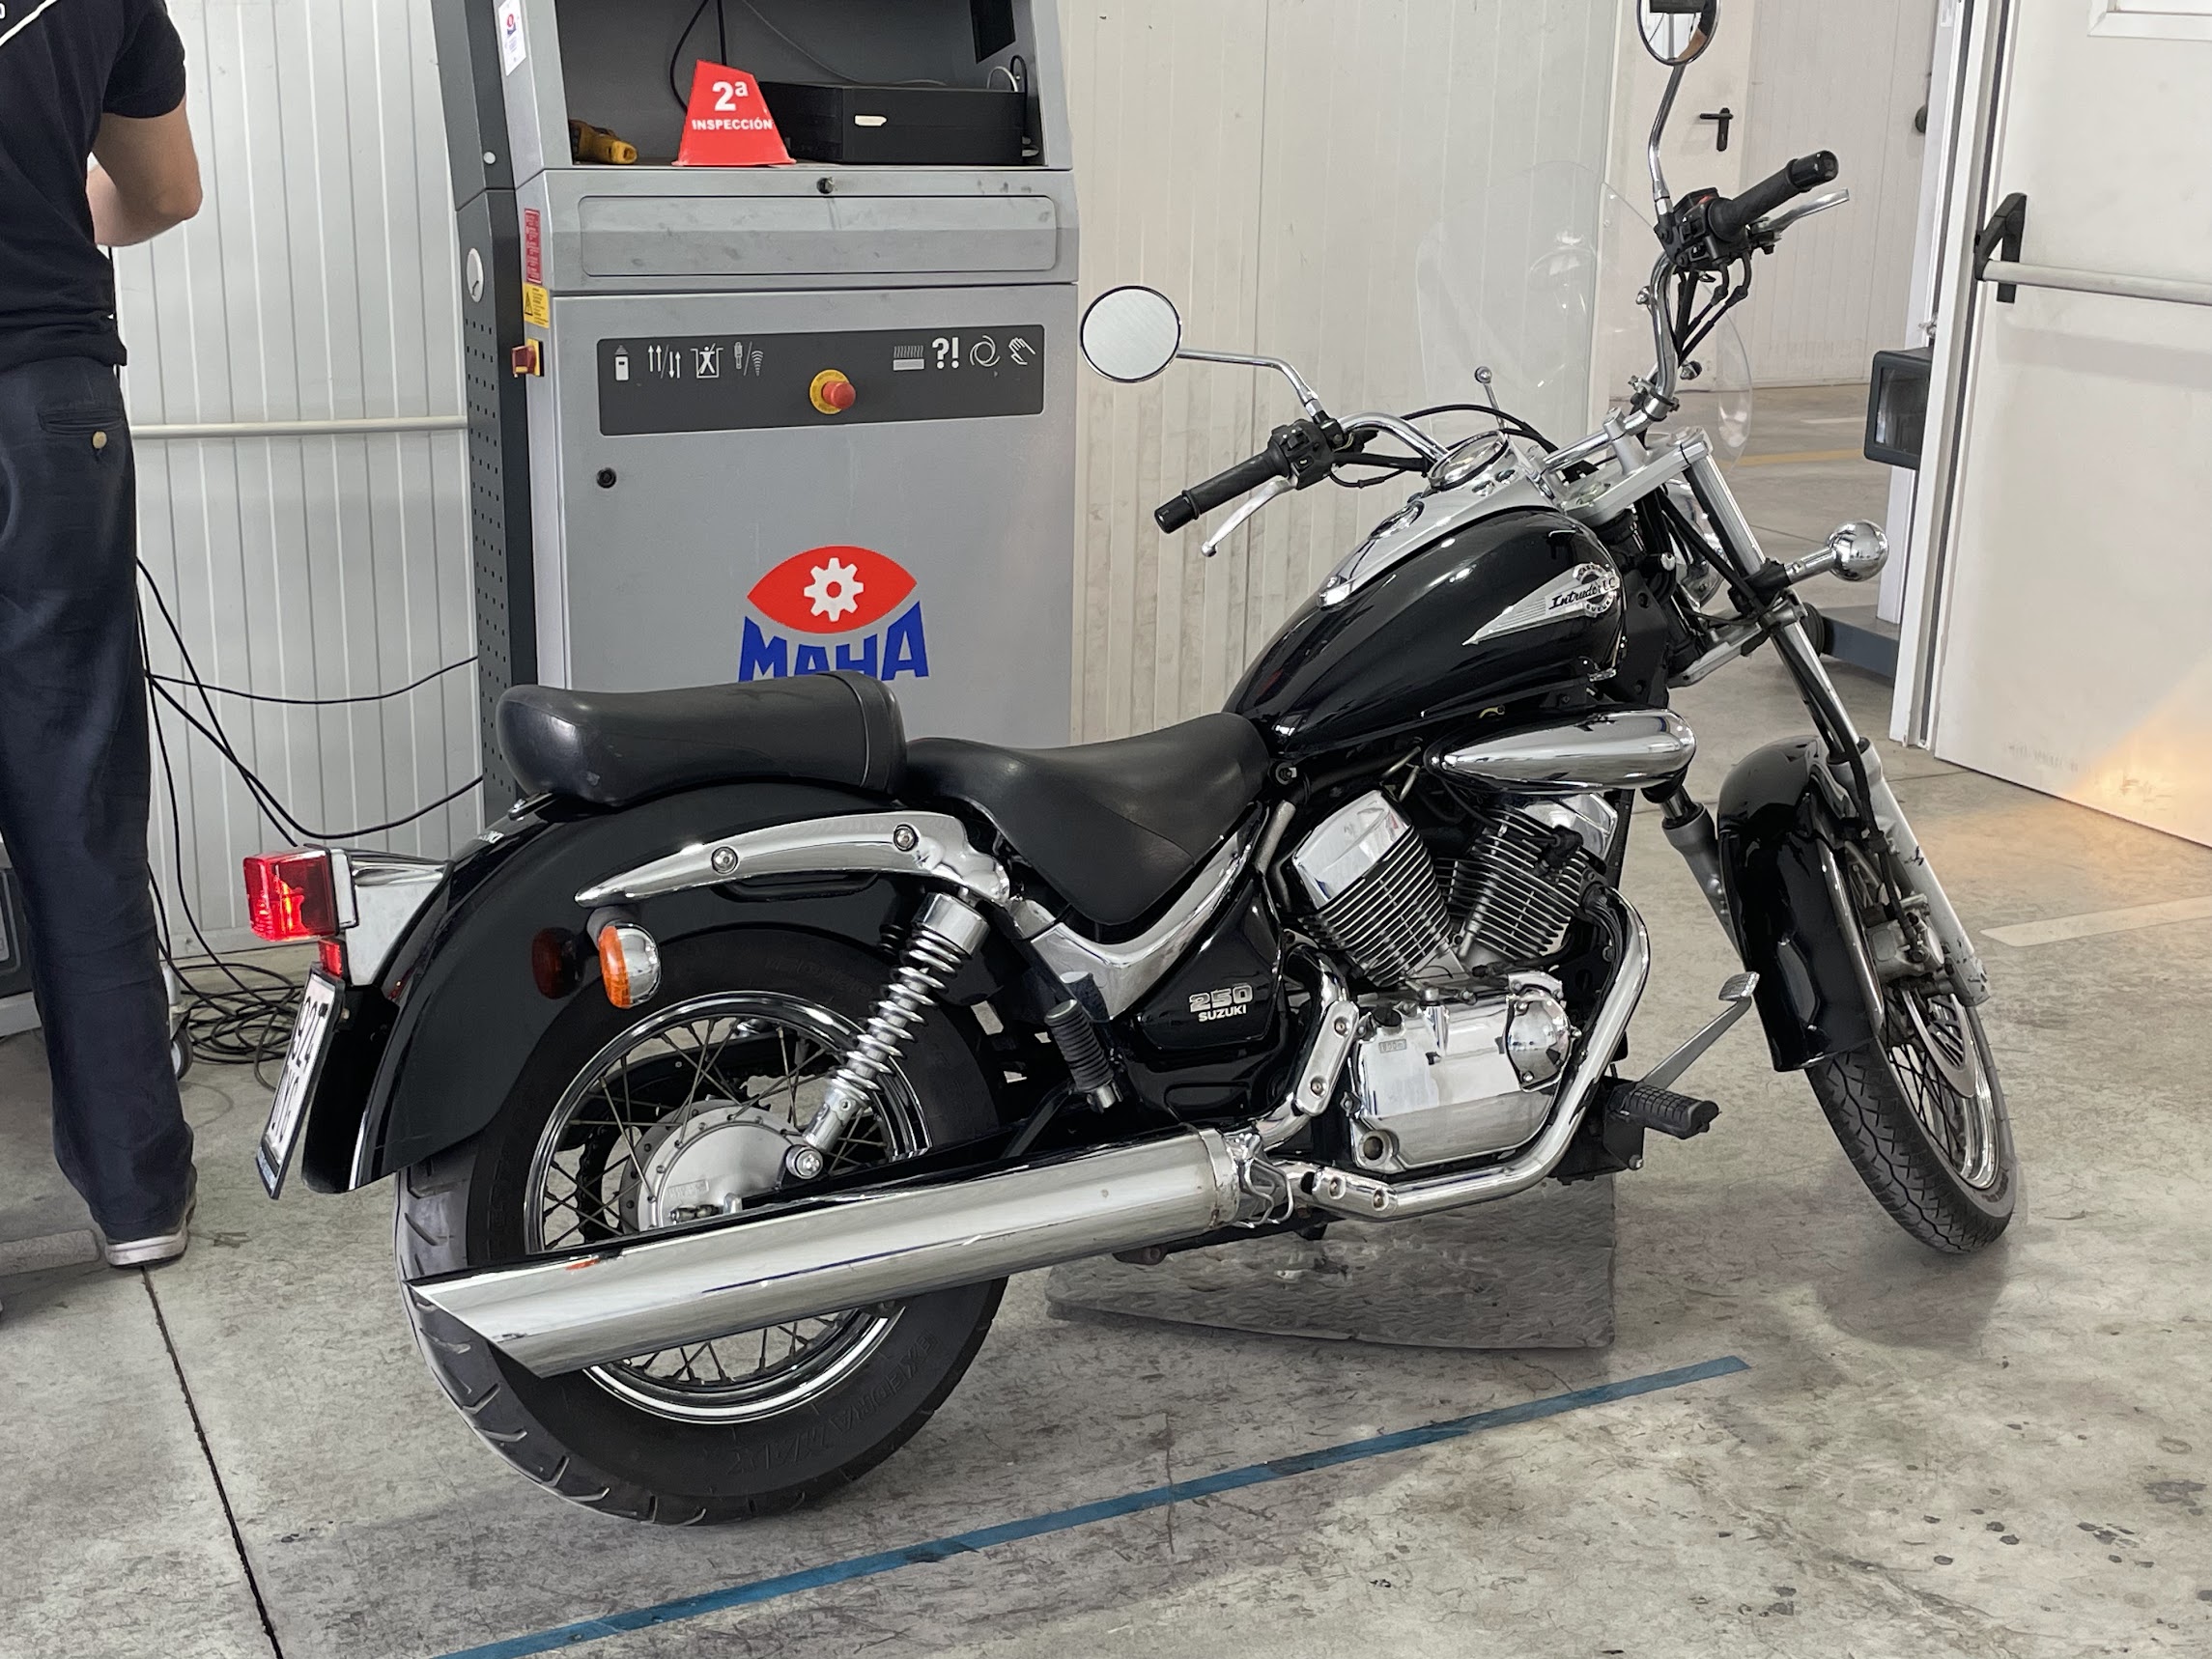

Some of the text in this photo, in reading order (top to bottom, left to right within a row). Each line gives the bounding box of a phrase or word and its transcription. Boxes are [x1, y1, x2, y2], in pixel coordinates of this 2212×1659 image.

[712, 80, 750, 112] 2ª
[691, 116, 773, 130] INSPECCIÓN
[737, 600, 929, 682] MAHA
[1189, 984, 1253, 1012] 250
[1199, 1004, 1246, 1023] SUZUKI
